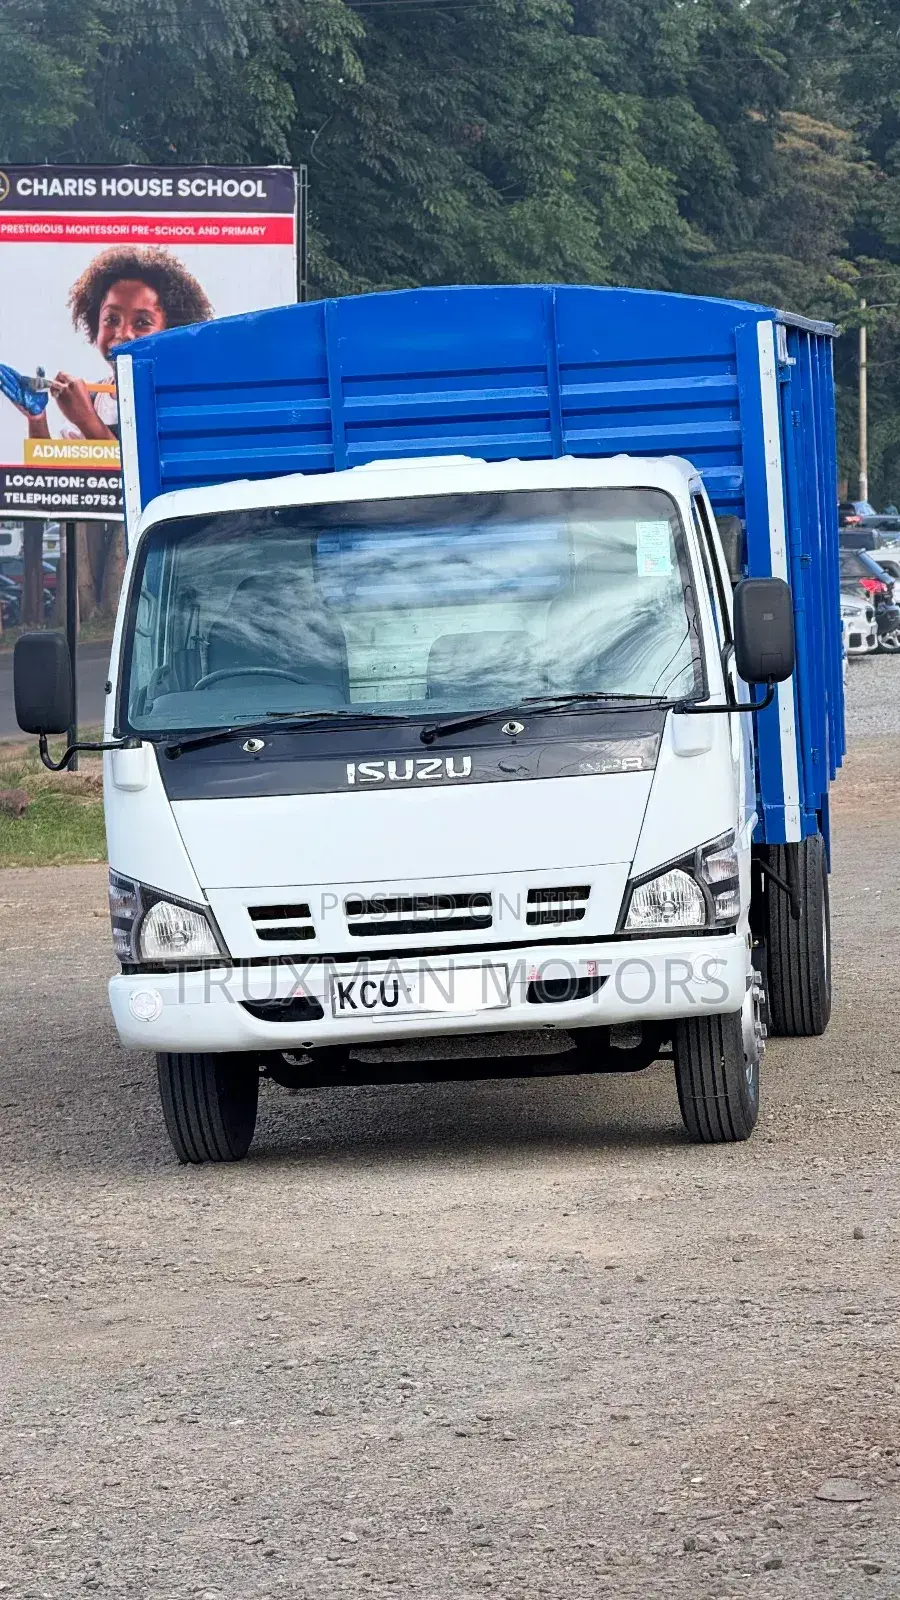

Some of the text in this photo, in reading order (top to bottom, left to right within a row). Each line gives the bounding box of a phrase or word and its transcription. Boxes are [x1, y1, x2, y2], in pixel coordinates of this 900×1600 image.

[16, 177, 267, 198] CHARIS HOUSE SCHOOL
[1, 224, 267, 237] PRESTIGIOUS MONTESSORI PRE-SCHOOL AND PRIMARY
[33, 445, 121, 459] ADMISSIONS
[5, 474, 85, 489] LOCATION:
[4, 492, 79, 506] TELEPHONE
[81, 494, 117, 506] :0753
[346, 756, 472, 785] ISUZU
[337, 979, 400, 1010] KCU
